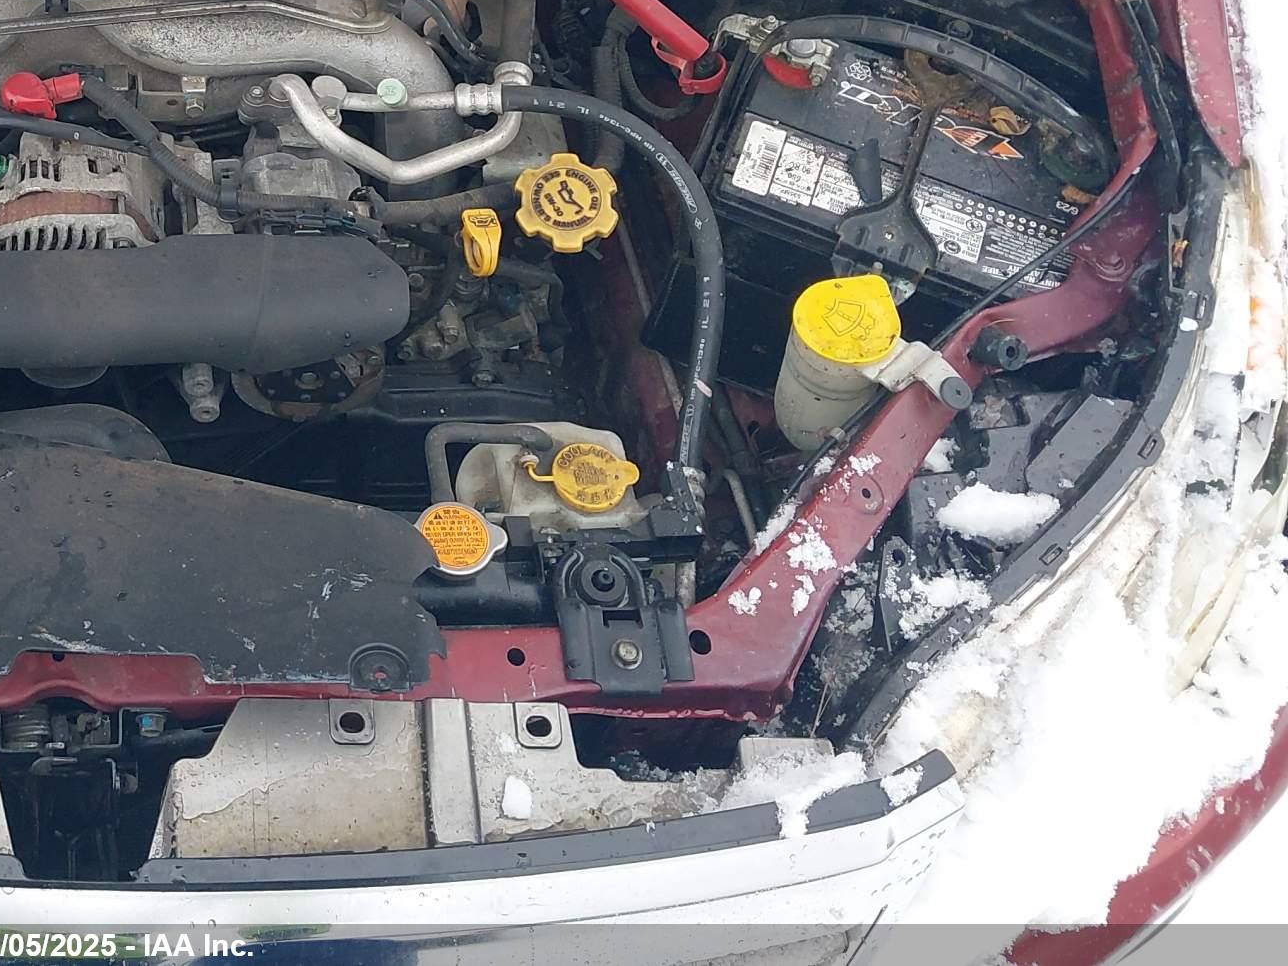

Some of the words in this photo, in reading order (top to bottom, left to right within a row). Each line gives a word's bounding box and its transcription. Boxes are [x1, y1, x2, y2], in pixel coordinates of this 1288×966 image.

[566, 170, 598, 194] ENGINE
[589, 196, 599, 211] OIL
[1056, 200, 1080, 216] 6/23
